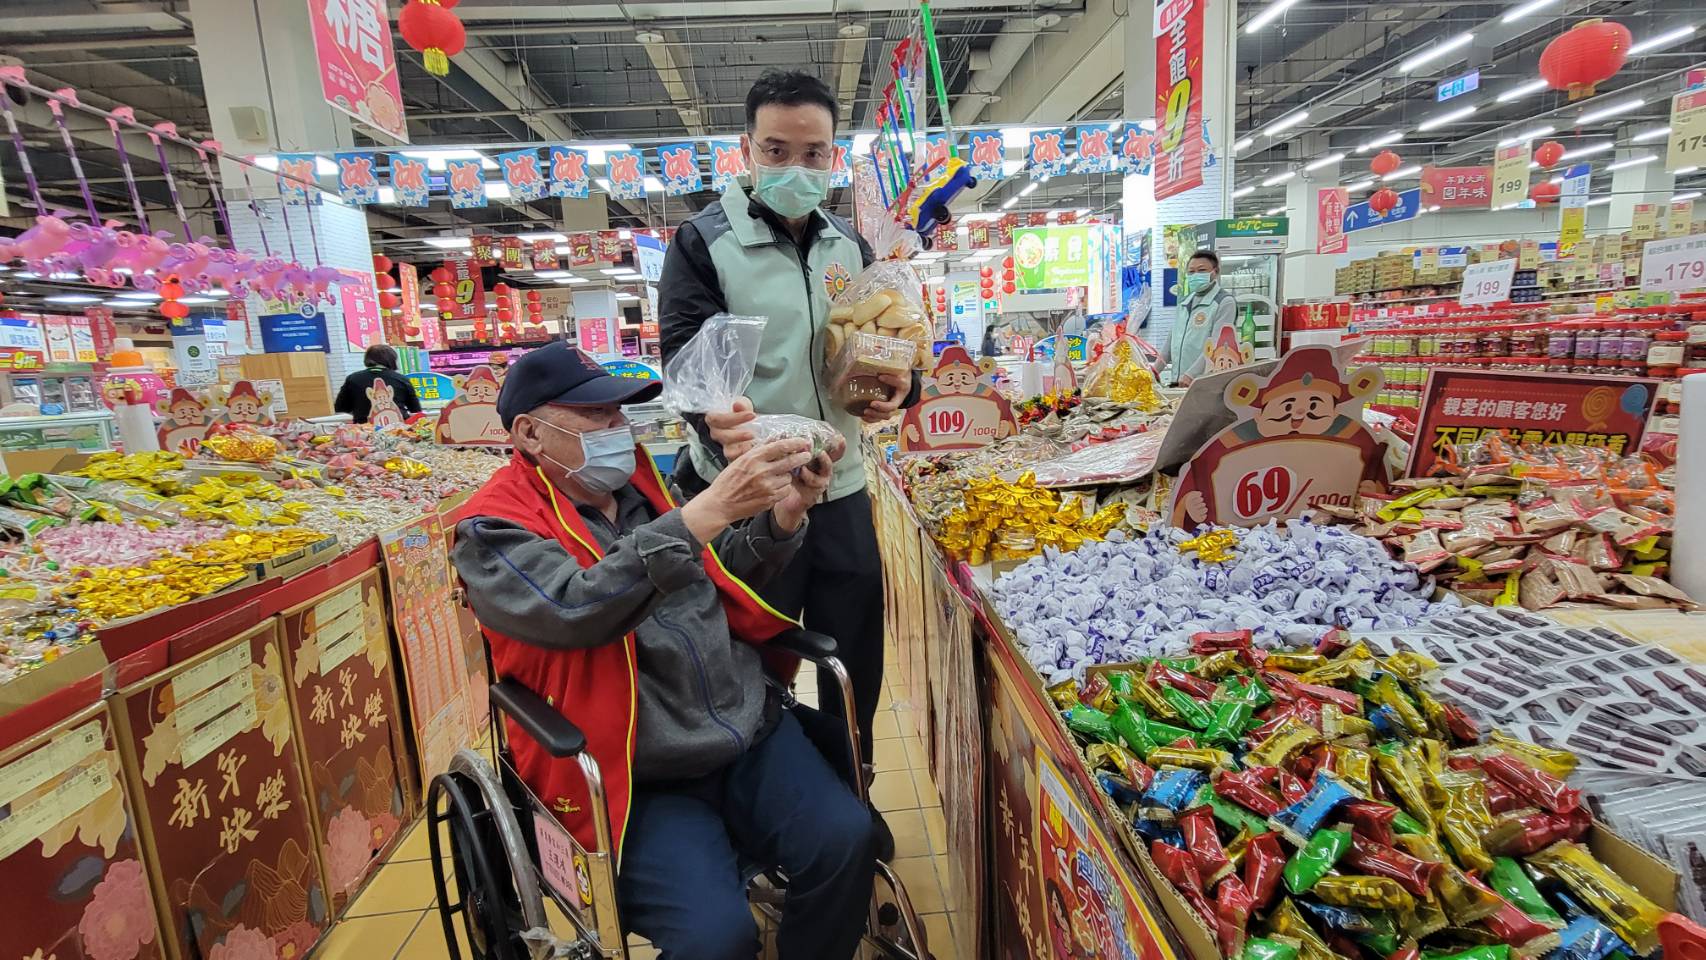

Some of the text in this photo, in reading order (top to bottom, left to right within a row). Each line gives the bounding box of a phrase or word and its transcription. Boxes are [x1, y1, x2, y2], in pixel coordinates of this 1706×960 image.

[1498, 179, 1522, 194] 199
[1665, 260, 1705, 281] 179
[1475, 280, 1501, 296] 199
[1442, 396, 1568, 422] 親愛的顧客您好
